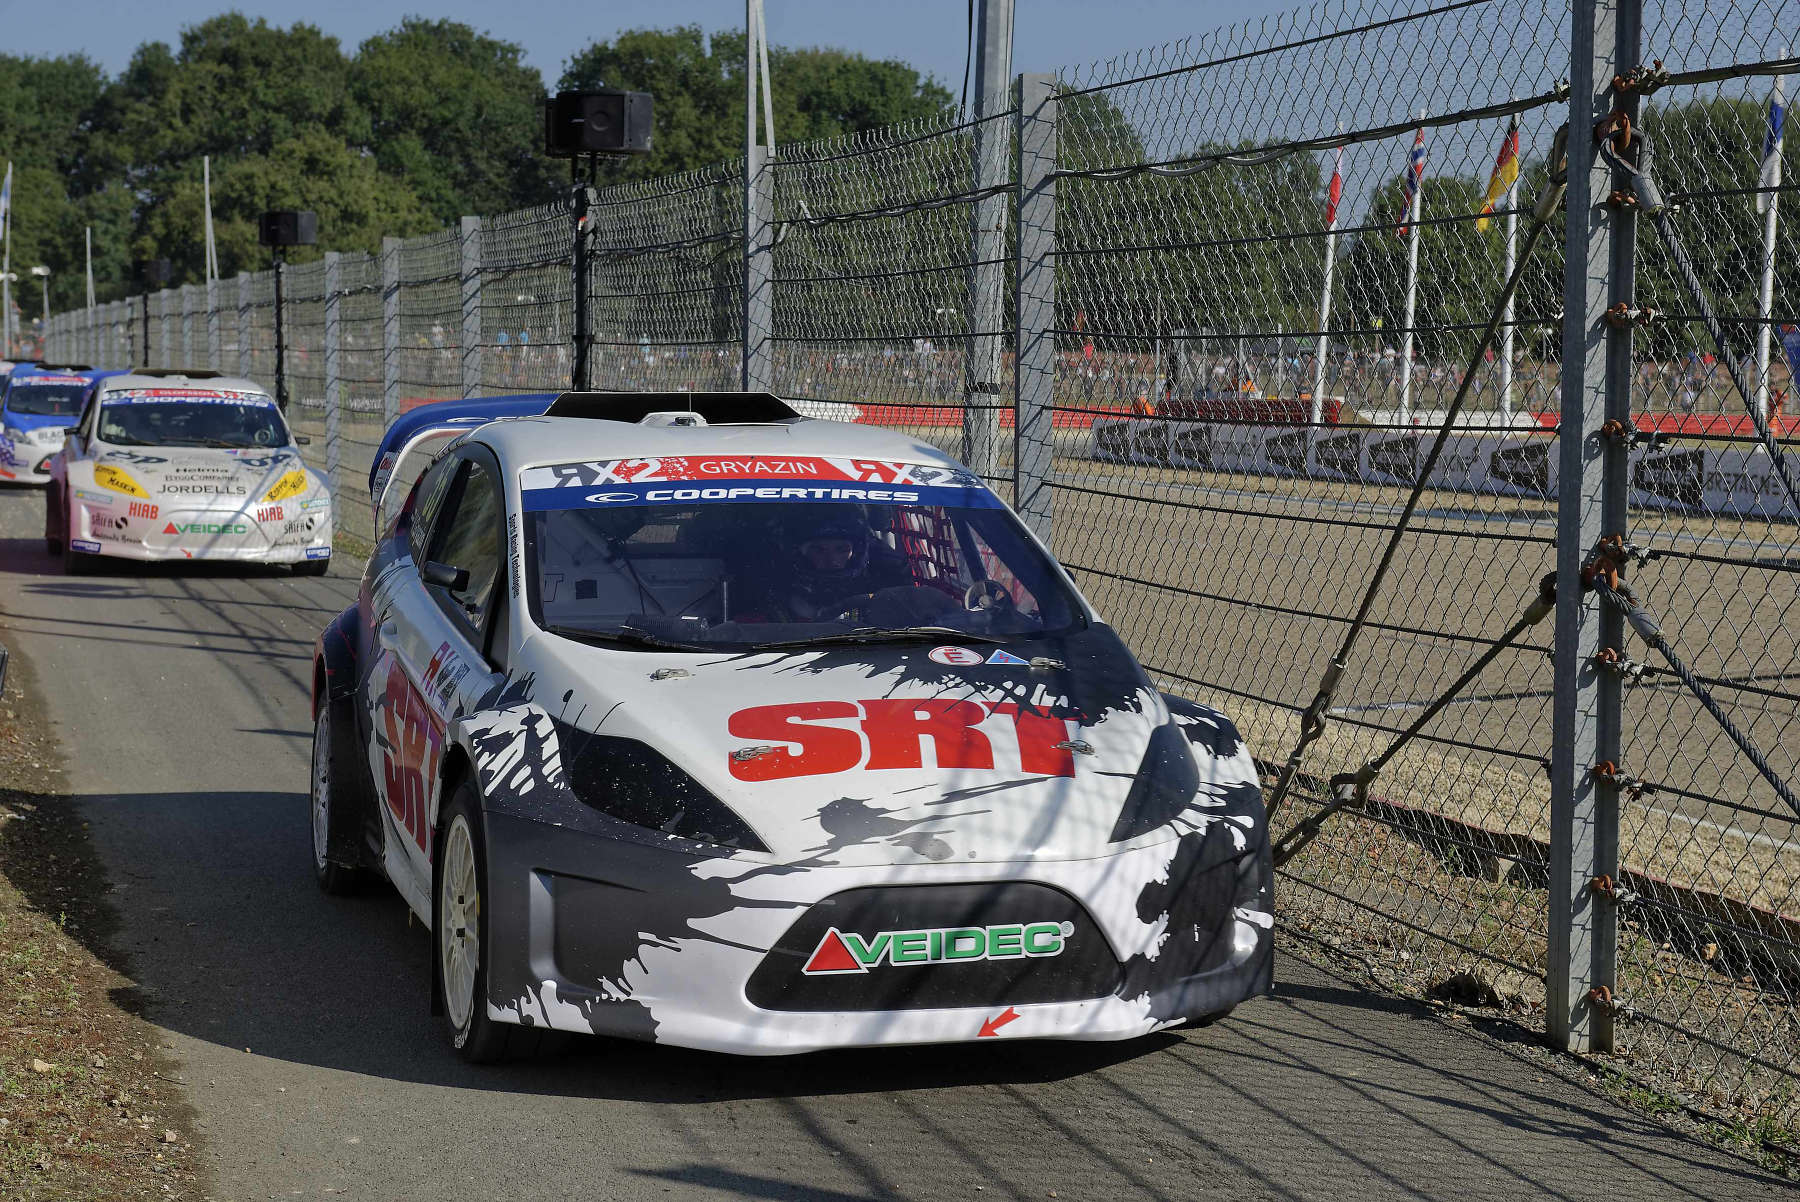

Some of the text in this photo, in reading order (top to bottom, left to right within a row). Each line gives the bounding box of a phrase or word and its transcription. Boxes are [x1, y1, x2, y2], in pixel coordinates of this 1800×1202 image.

[700, 460, 818, 475] GRYAZIN
[156, 484, 247, 495] JORDELLS
[645, 487, 919, 503] COOPERTIRES
[128, 502, 159, 520] HIAB
[257, 506, 284, 522] HIAB
[175, 524, 248, 534] VEIDEC
[728, 699, 1076, 783] SRT
